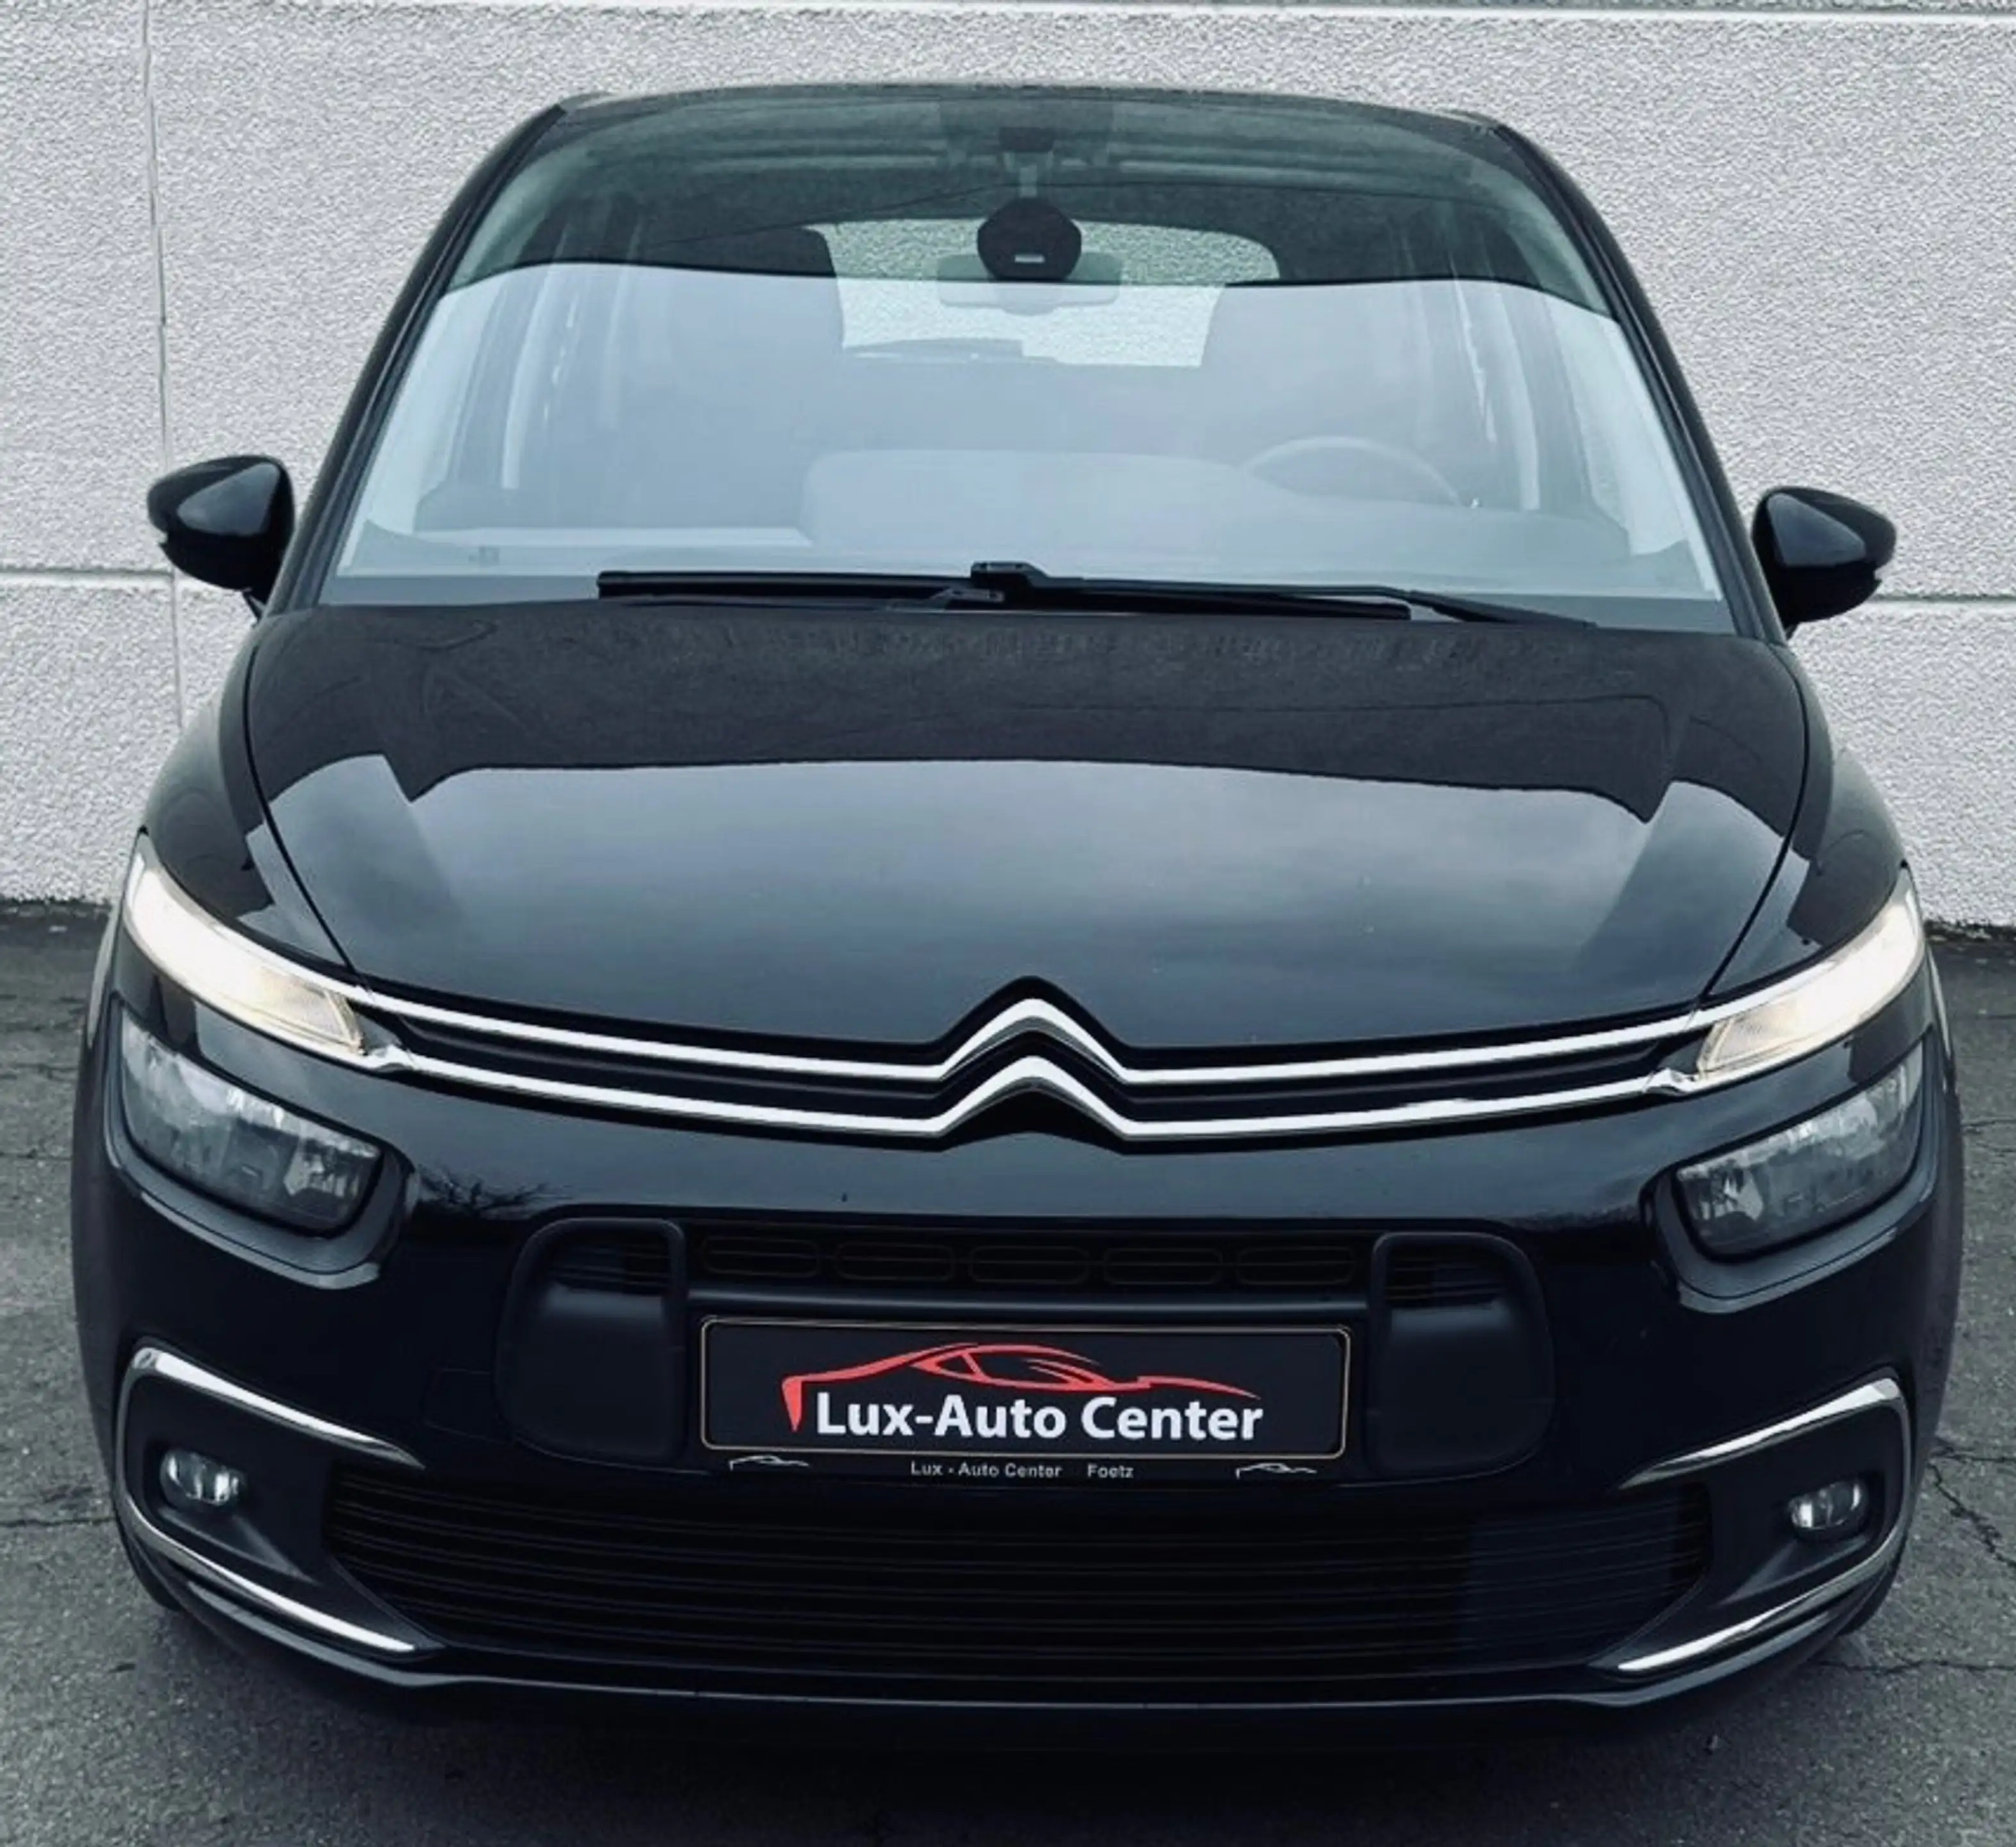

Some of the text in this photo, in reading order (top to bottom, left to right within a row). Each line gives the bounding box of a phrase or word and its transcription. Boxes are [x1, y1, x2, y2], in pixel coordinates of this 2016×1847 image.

[817, 1392, 1264, 1441] Lux-Auto Center
[911, 1460, 943, 1476] Lux
[958, 1461, 1000, 1477] Auto
[1004, 1462, 1063, 1478] Center
